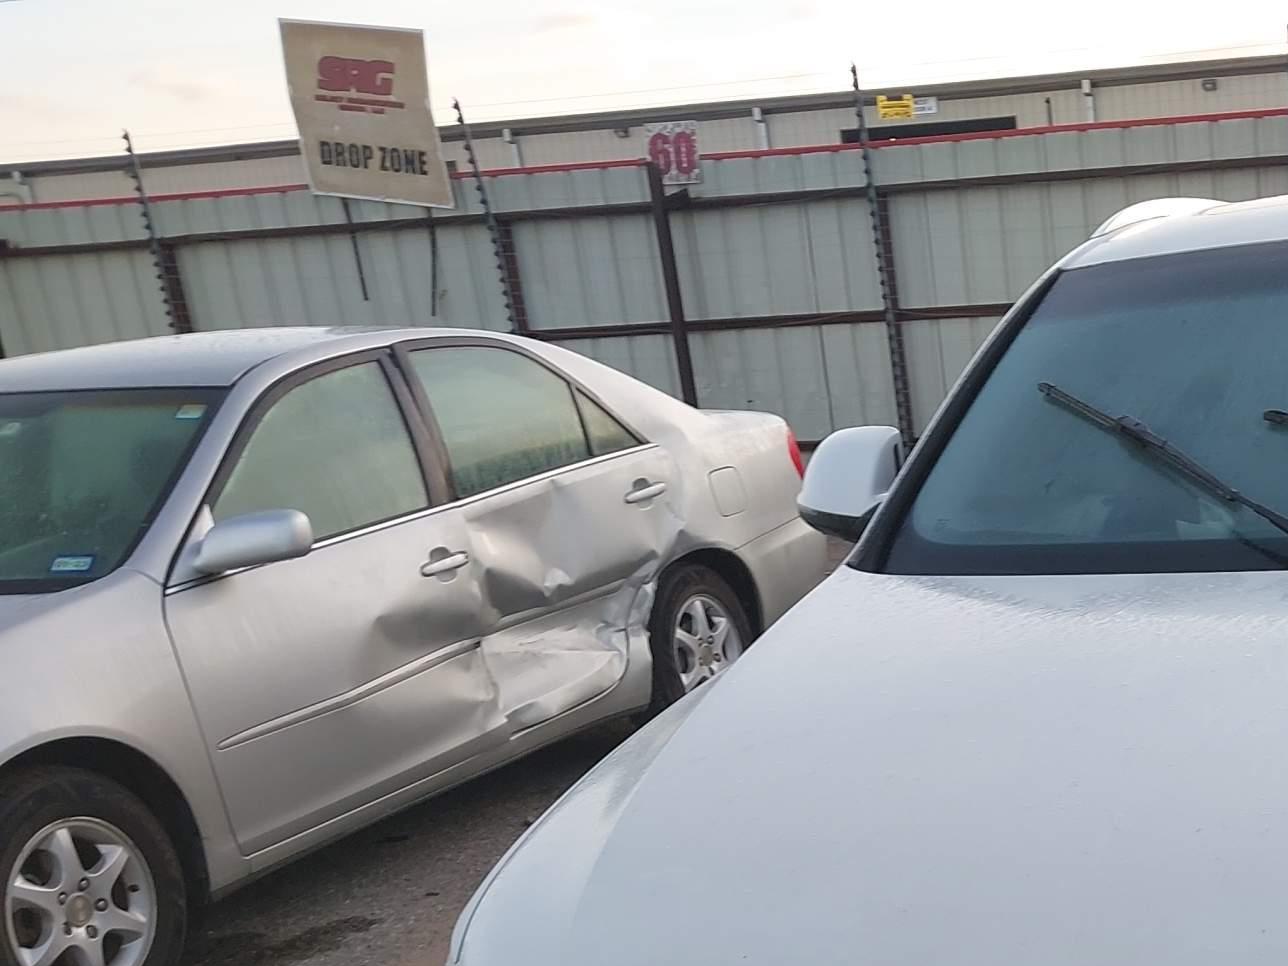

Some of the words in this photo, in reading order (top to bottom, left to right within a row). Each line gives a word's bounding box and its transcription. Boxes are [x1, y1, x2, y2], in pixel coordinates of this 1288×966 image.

[319, 140, 374, 170] DROP
[377, 146, 429, 176] ZONE
[649, 131, 697, 175] 60
